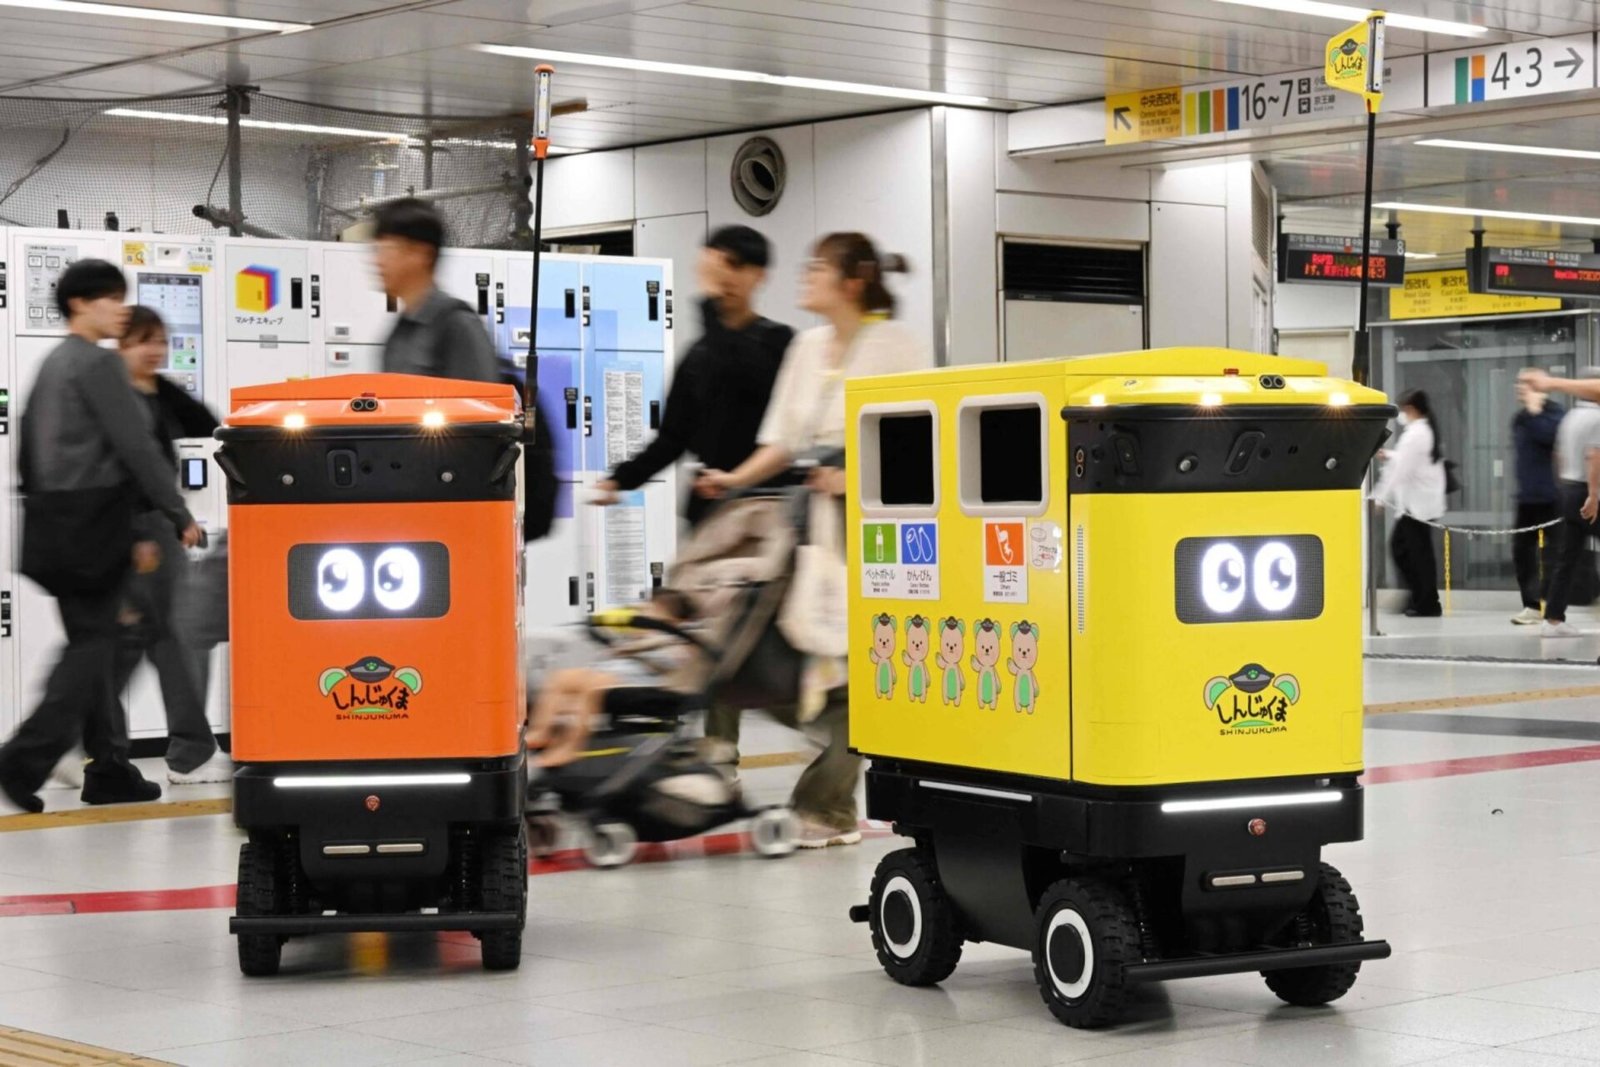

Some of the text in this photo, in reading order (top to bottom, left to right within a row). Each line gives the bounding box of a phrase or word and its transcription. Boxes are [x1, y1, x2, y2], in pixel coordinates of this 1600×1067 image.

[1397, 241, 1404, 255] 8
[865, 568, 896, 580] ペットボトル
[993, 570, 1018, 583] 一般ゴミ
[332, 683, 410, 710] しんじゅくま
[1216, 694, 1288, 724] しんじゅくま
[1220, 726, 1287, 736] SHINJUKUMA
